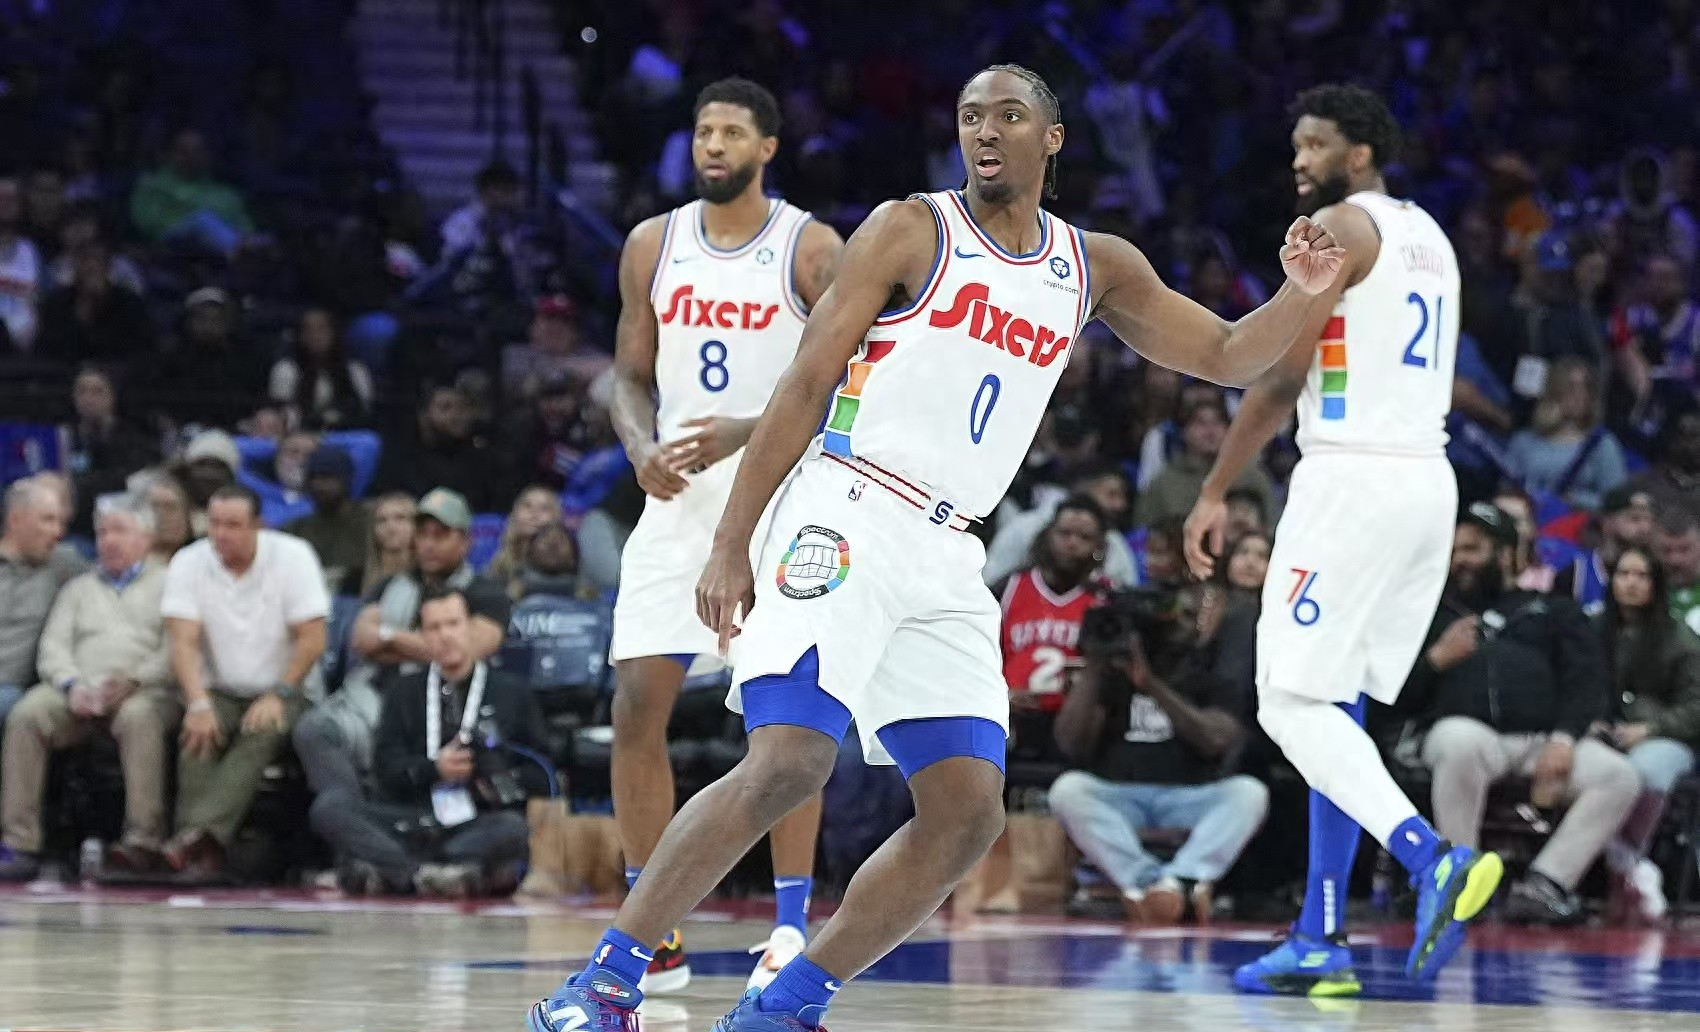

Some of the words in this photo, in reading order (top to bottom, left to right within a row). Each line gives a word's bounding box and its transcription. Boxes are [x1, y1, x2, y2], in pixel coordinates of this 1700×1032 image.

[661, 285, 779, 330] Sixers
[929, 282, 1070, 367] Sixers
[1402, 292, 1442, 370] 21
[700, 340, 729, 392] 8
[970, 374, 1001, 445] 0
[800, 526, 839, 539] Spectrum
[1288, 568, 1320, 626] 76
